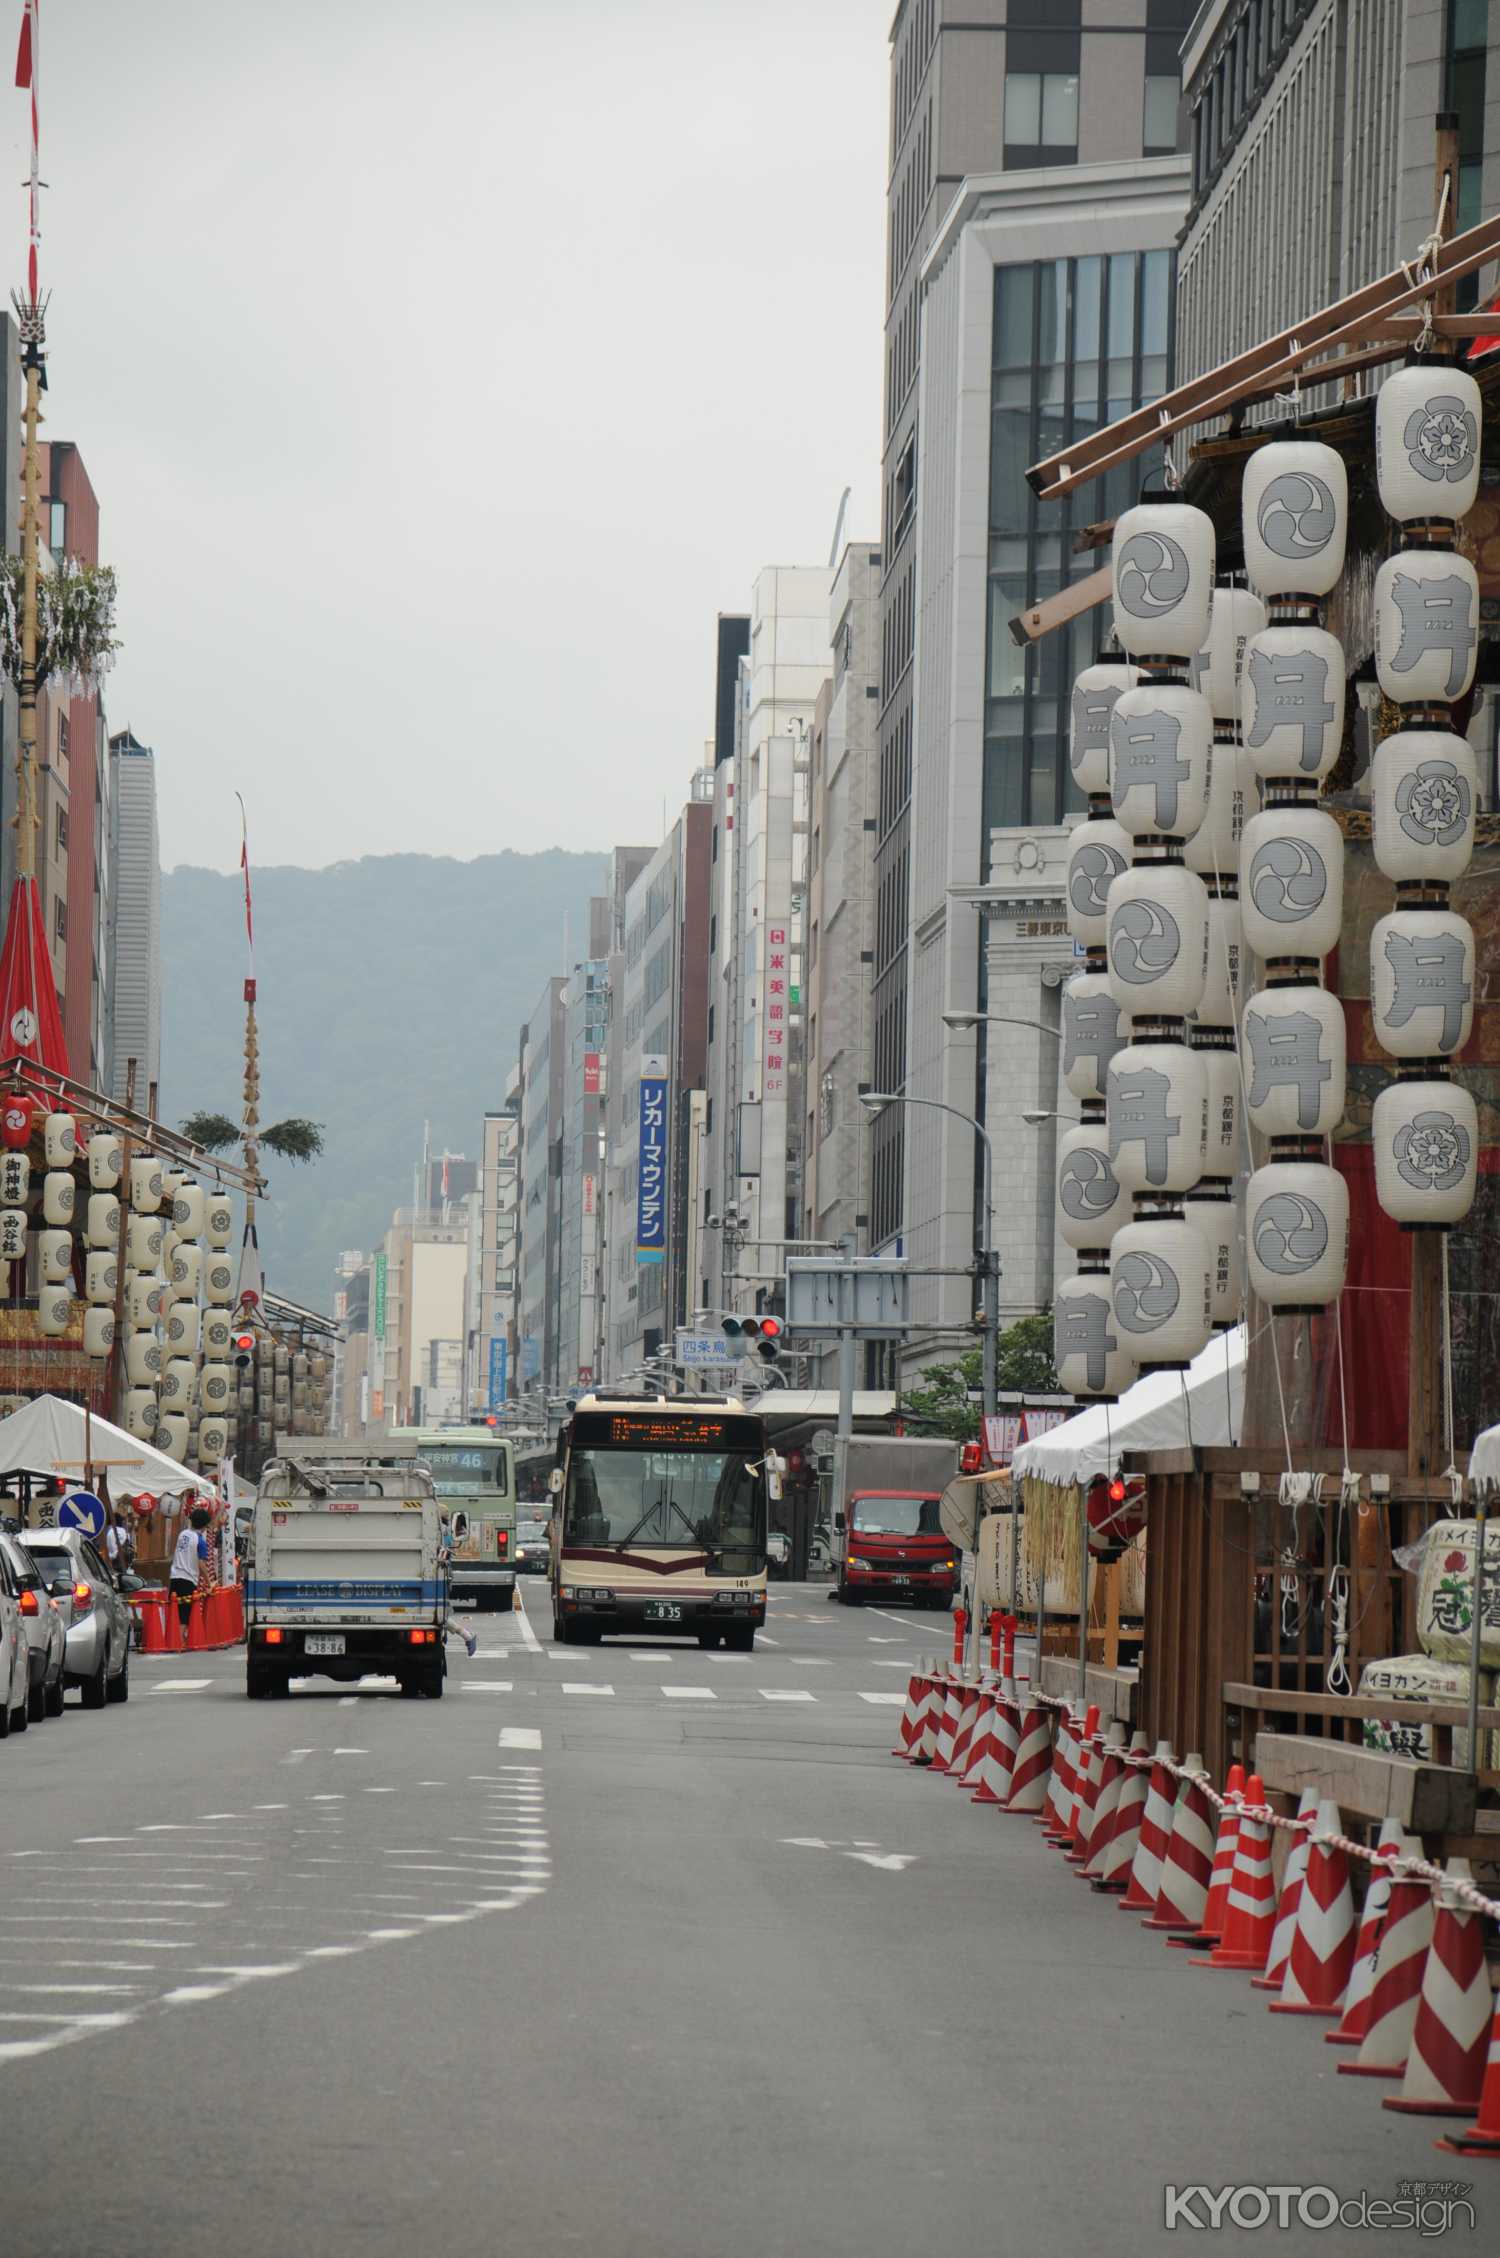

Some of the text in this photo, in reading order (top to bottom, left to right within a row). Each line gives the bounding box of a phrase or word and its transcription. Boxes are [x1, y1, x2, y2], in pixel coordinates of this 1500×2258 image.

[768, 929, 785, 1070] 日米英語学院
[767, 1079, 783, 1090] 6F
[1221, 1095, 1234, 1147] 京都銀行
[641, 1088, 664, 1239] リカーマウンテン
[1216, 1244, 1230, 1294] 京都銀行
[461, 1452, 481, 1468] 46
[296, 1583, 403, 1598] LEASE DISPLAY
[736, 1579, 749, 1589] 149
